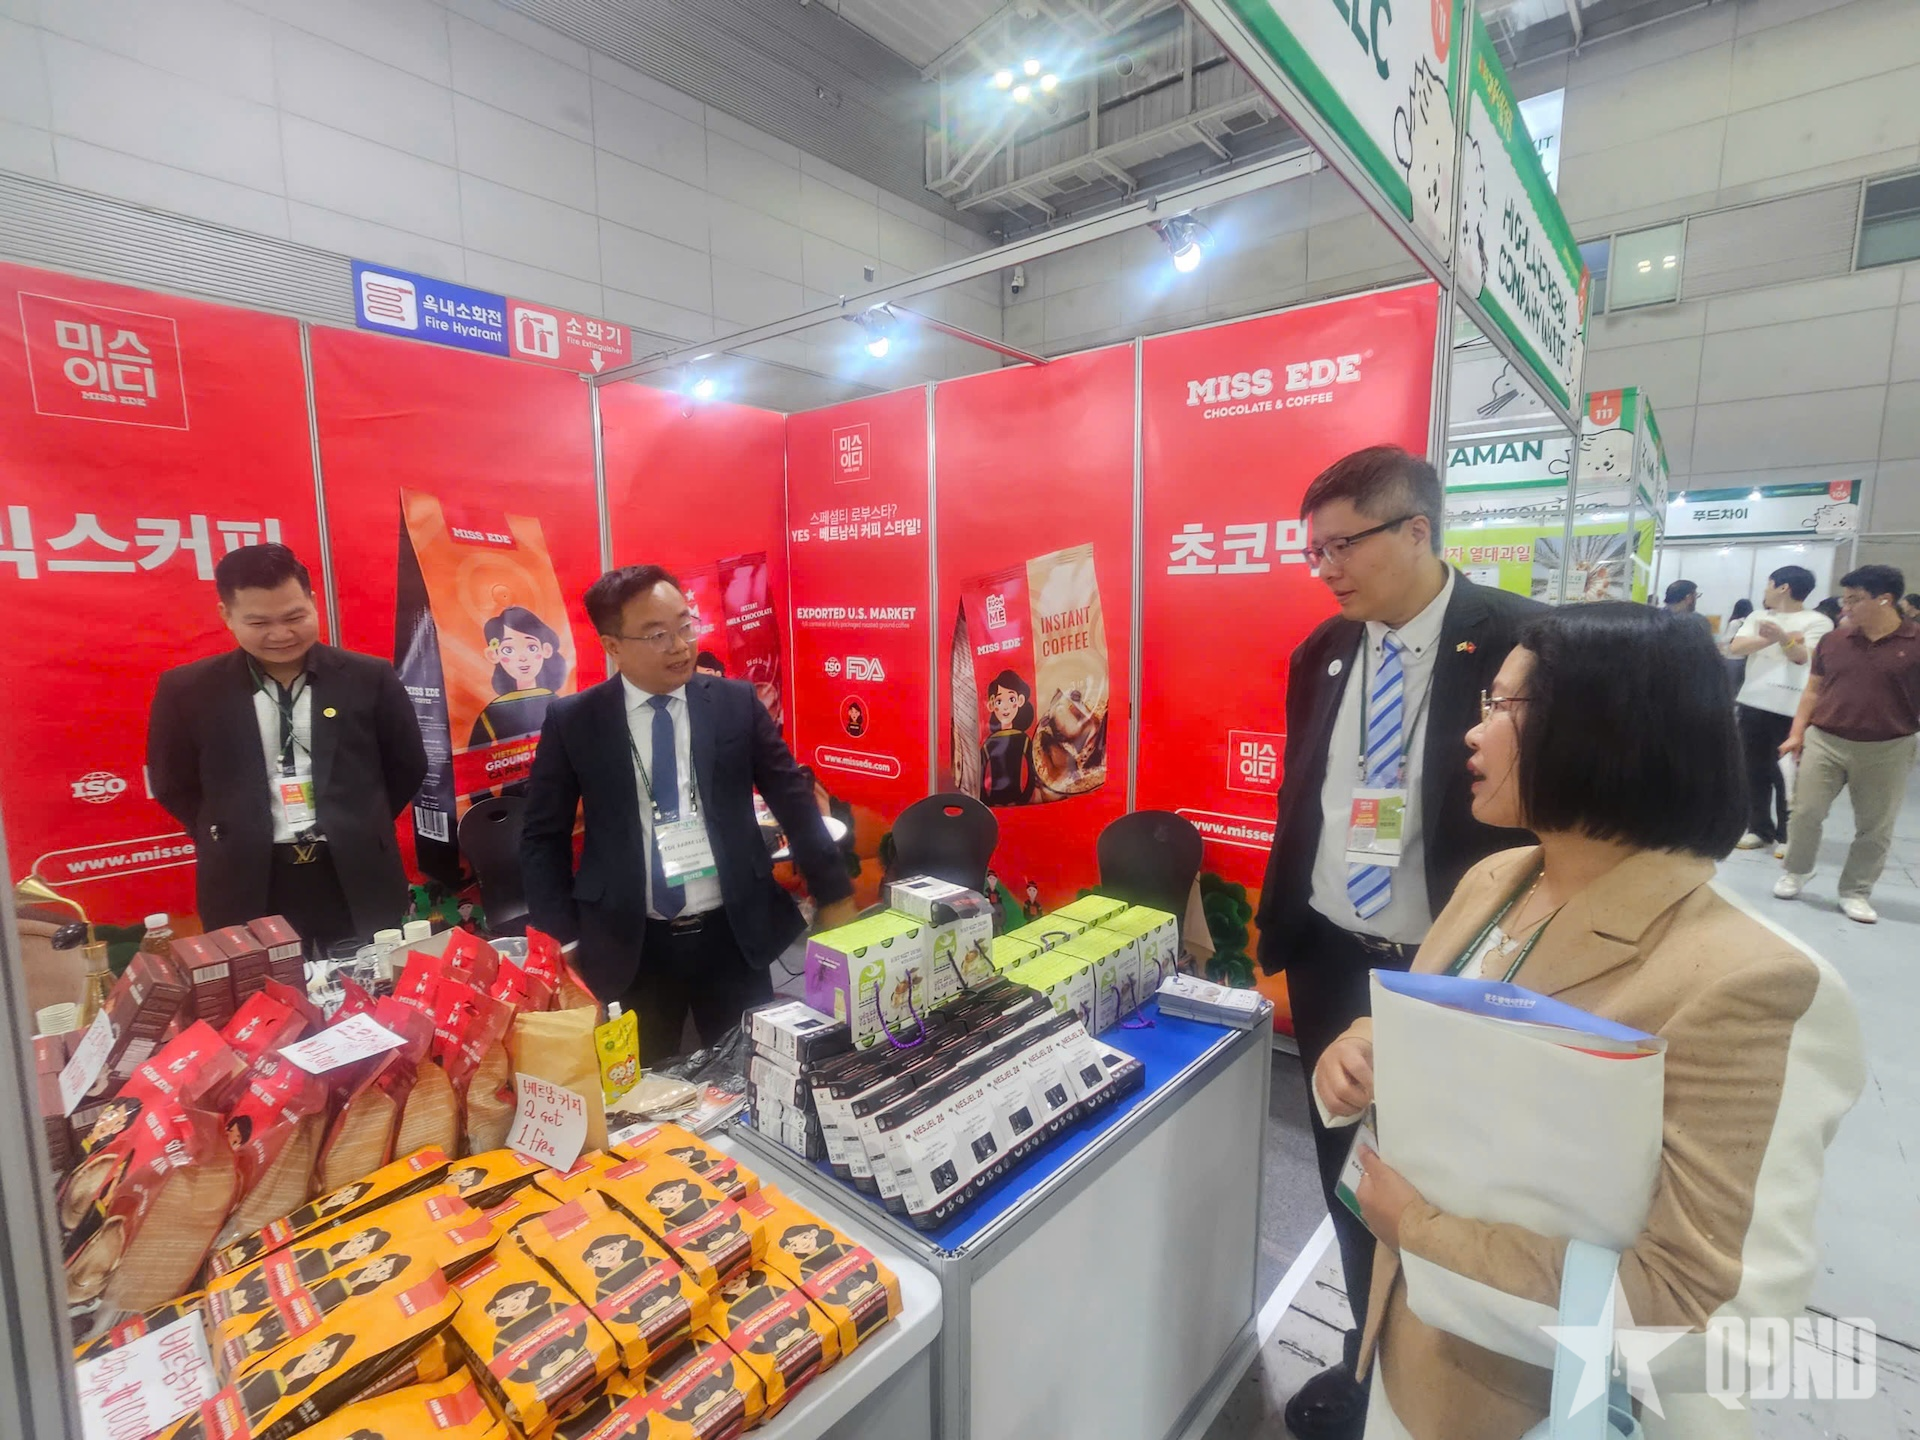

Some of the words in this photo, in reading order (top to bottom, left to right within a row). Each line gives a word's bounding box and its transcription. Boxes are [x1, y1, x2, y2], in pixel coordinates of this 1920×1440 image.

[423, 295, 502, 328] 옥내소화전
[425, 314, 449, 331] Fire
[453, 322, 502, 342] Hydrant
[54, 320, 153, 365] 미스
[566, 336, 580, 346] Fire
[582, 340, 623, 355] Extinguisher
[63, 356, 157, 398] 이디
[1187, 369, 1273, 406] MISS
[1285, 354, 1361, 391] EDE
[1203, 399, 1272, 419] CHOCOLATE
[1275, 400, 1283, 410] &
[1286, 391, 1333, 408] COFFEE
[840, 434, 862, 452] 미스
[840, 451, 862, 468] 이디
[1446, 440, 1544, 468] AMAN
[1693, 508, 1749, 521] 푸드차이
[453, 527, 484, 542] MISS
[487, 531, 512, 545] EDE
[791, 529, 810, 542] YES
[819, 523, 858, 542] 베트남식
[861, 521, 881, 539] 커피
[884, 518, 921, 537] 스타일!
[1470, 545, 1532, 563] 열대과일
[797, 608, 846, 619] EXPORTED
[847, 608, 867, 619] U.S.
[870, 607, 916, 620] MARKET
[1041, 605, 1091, 634] INSTANT
[977, 642, 999, 655] MISS
[1043, 631, 1089, 657] COFFEE
[824, 661, 841, 672] ISO
[846, 656, 885, 682] FDA
[485, 752, 531, 771] GROUND
[1240, 742, 1277, 762] 미스
[824, 753, 890, 773] www.missede.com
[1240, 760, 1276, 780] 이디
[71, 778, 127, 798] ISO
[524, 1100, 535, 1119] 2
[516, 1124, 528, 1146] 1
